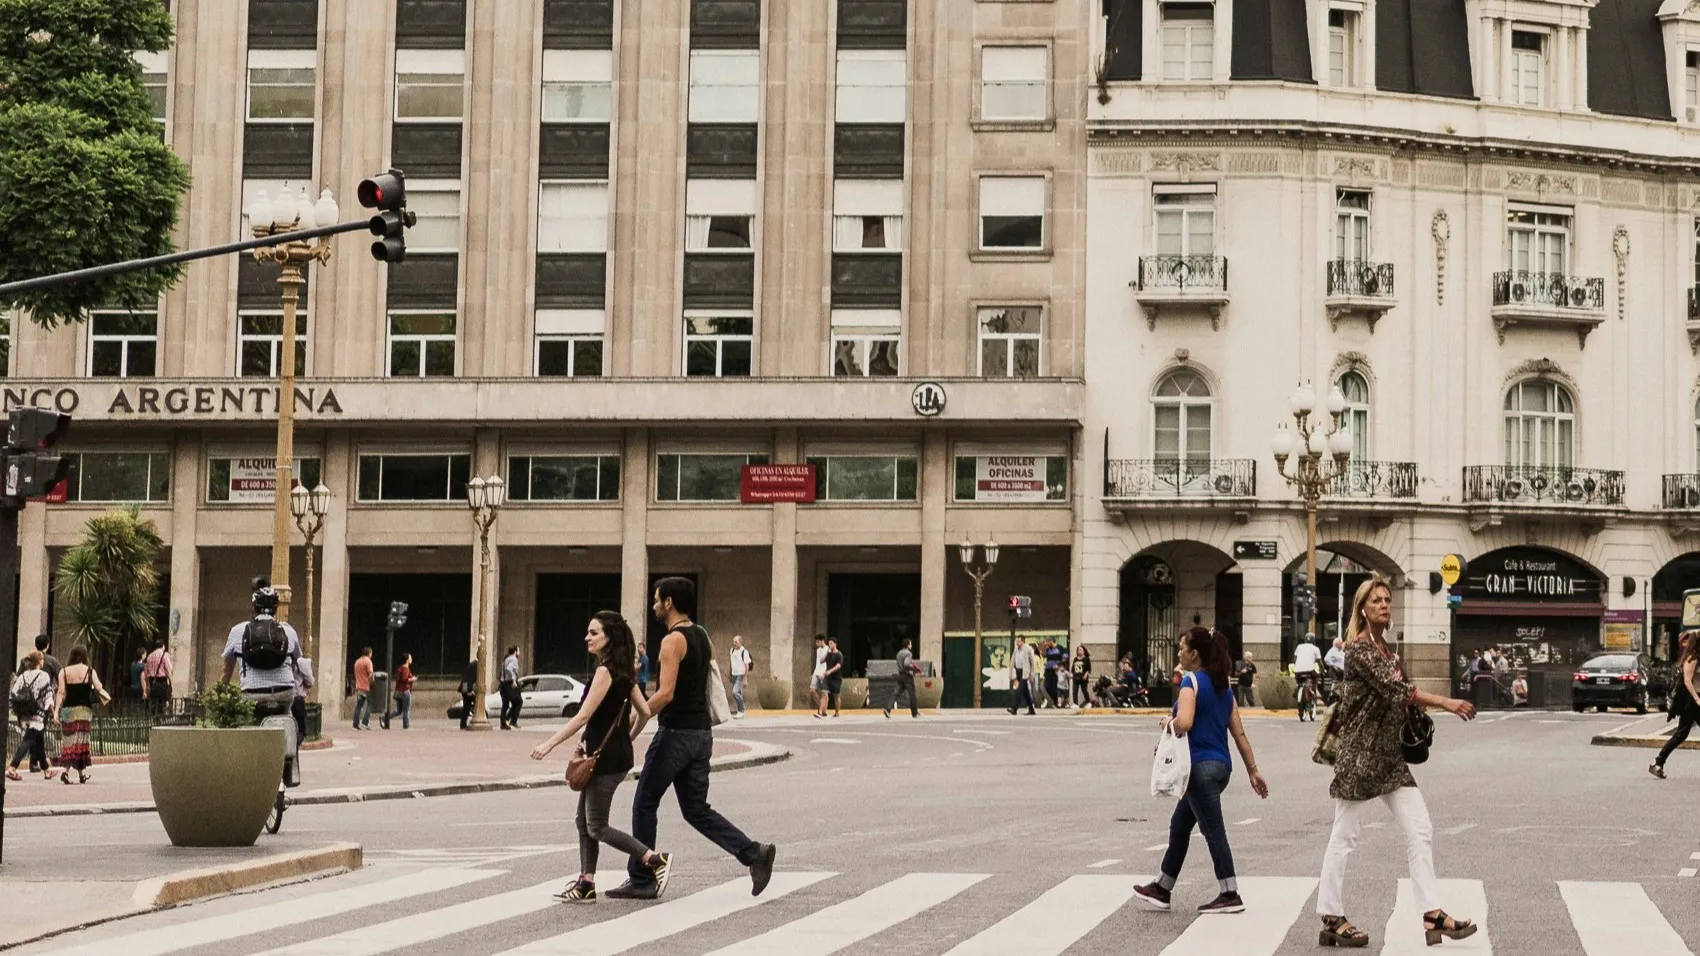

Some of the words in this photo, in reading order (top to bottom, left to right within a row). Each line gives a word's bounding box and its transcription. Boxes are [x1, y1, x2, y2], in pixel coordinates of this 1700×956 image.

[238, 459, 277, 470] ALQUIL
[988, 456, 1035, 467] ALQUILER
[749, 467, 774, 475] OFICINAS
[775, 467, 783, 475] EN
[783, 467, 809, 476] ALQUILER
[989, 469, 1034, 478] OFICINAS
[1526, 560, 1556, 571] Restaurant
[1486, 574, 1515, 593] GRAN
